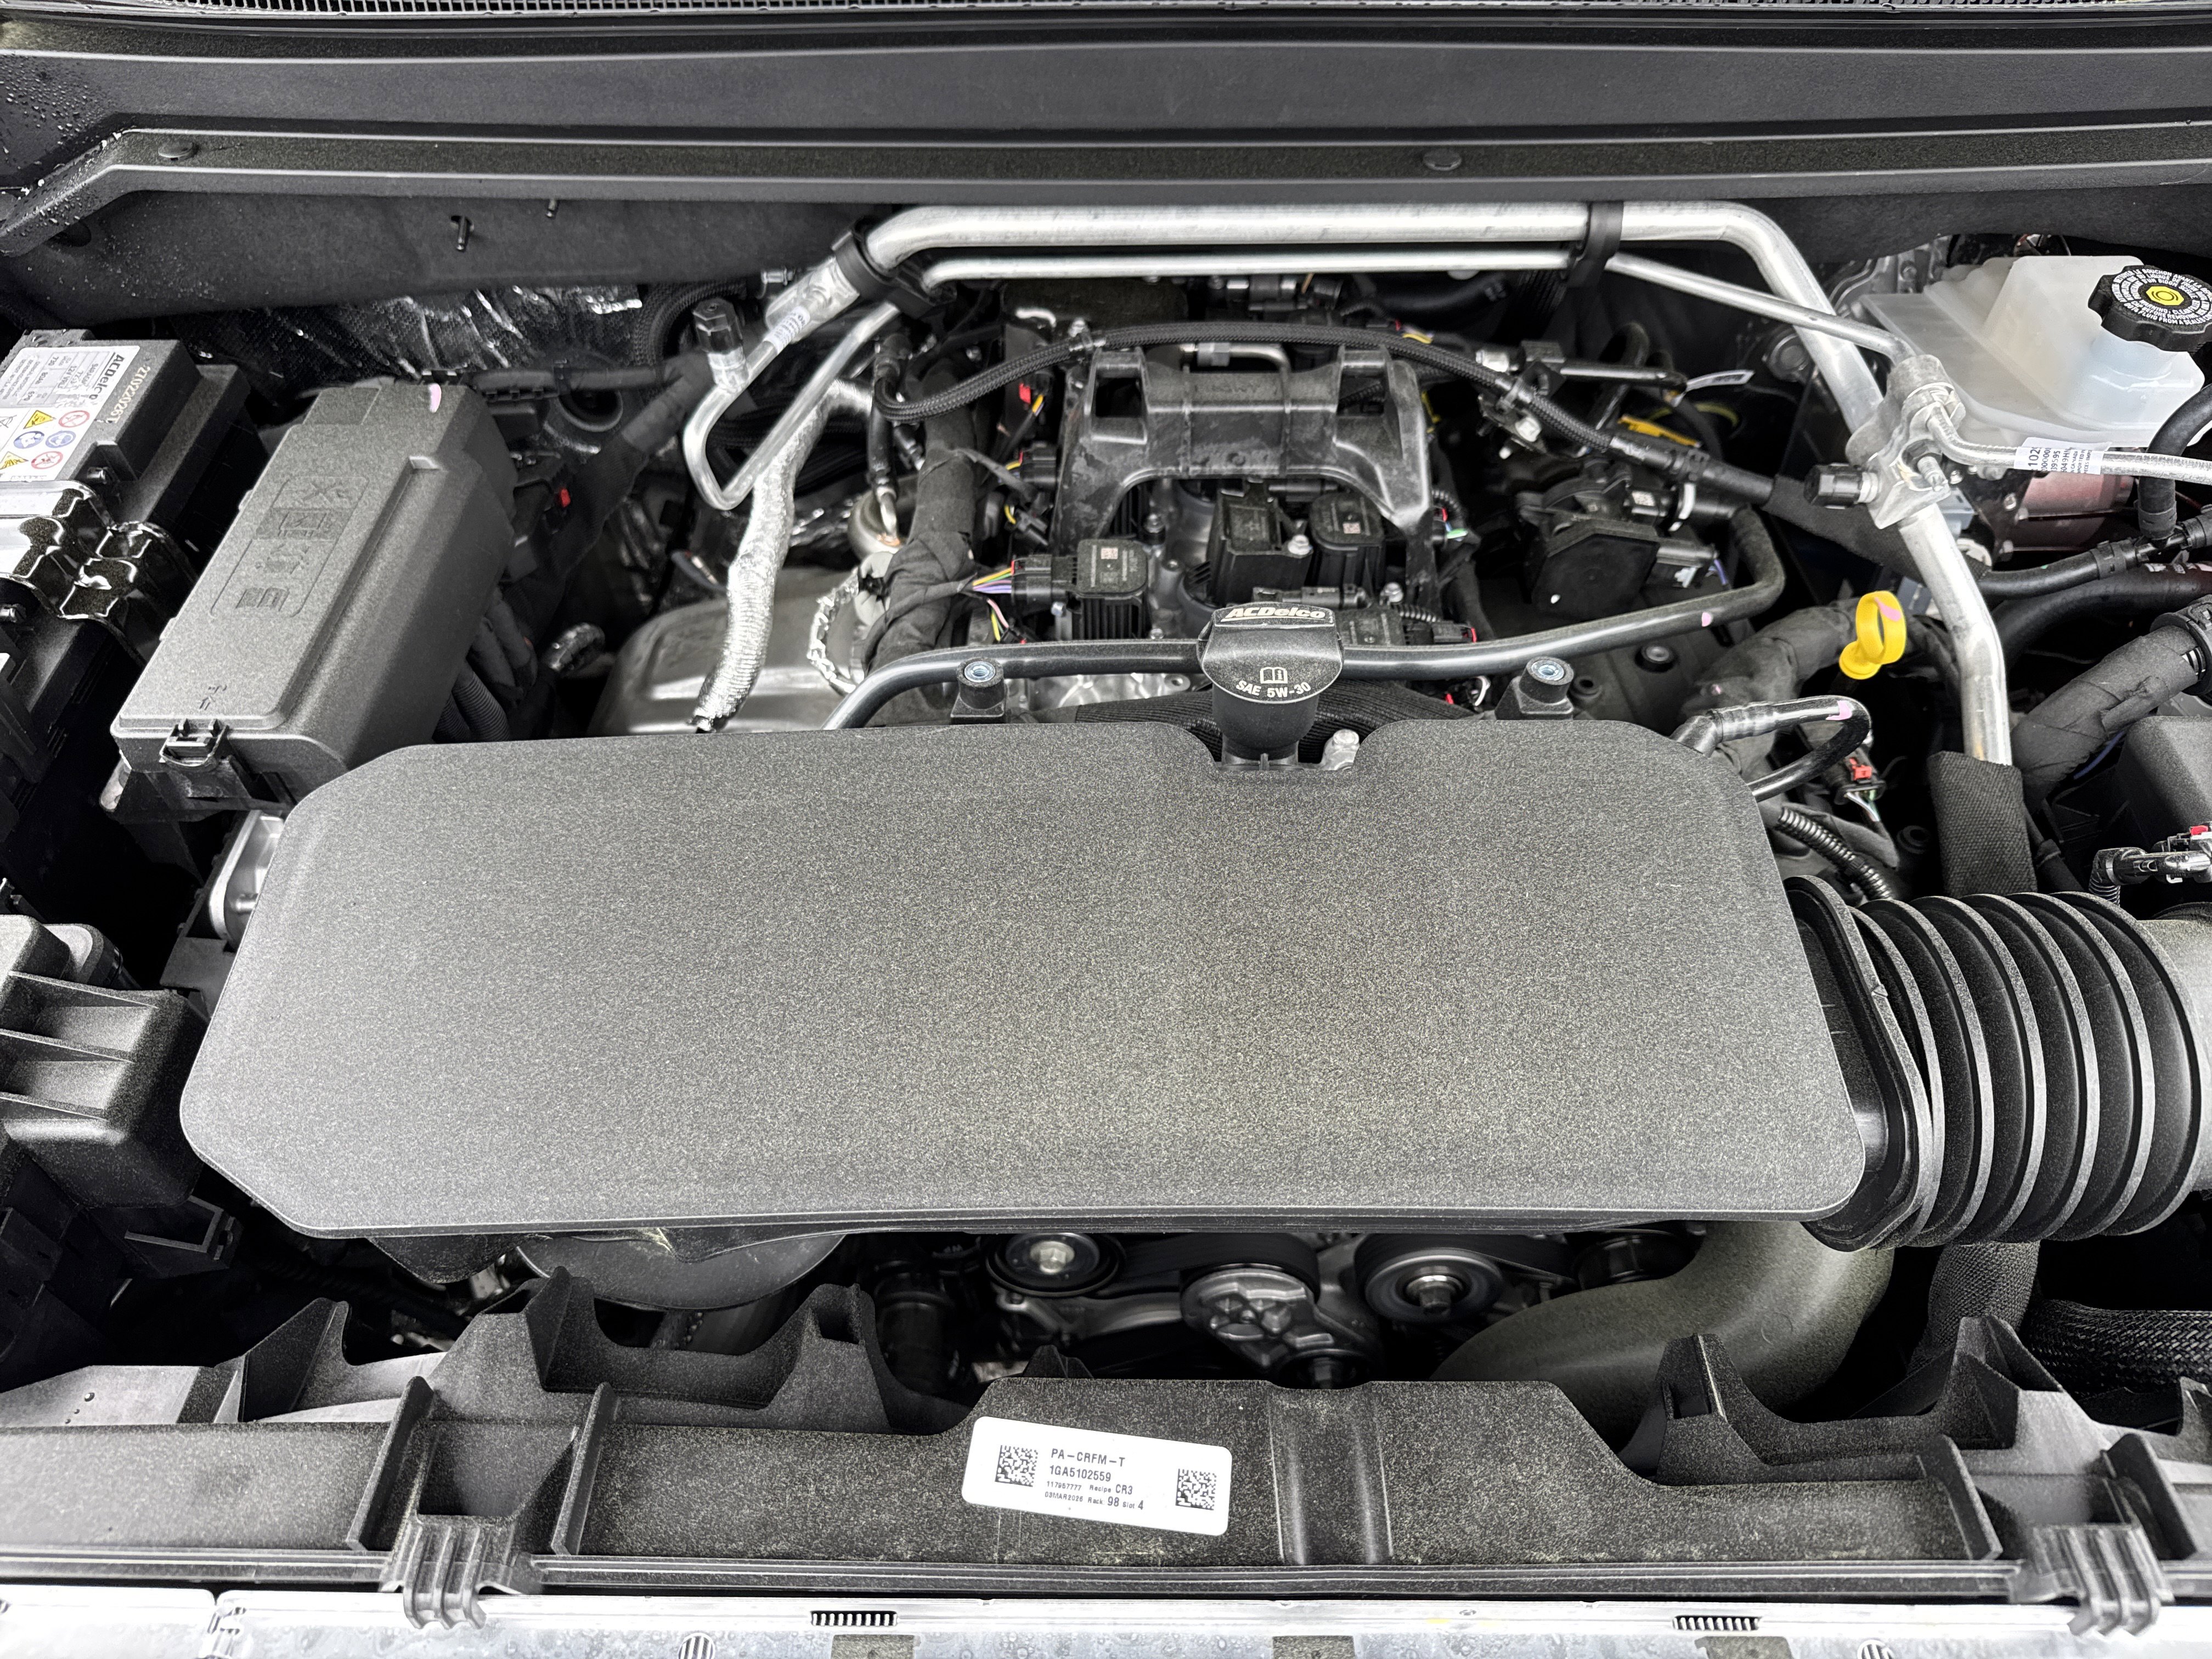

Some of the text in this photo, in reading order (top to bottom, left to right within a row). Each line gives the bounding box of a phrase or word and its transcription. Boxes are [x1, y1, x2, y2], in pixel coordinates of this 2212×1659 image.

[2158, 279, 2178, 287] BIDON
[2173, 274, 2194, 284] AVANT
[2138, 311, 2158, 320] FLUID
[2158, 315, 2178, 325] FROM
[2141, 307, 2166, 318] BEFORE
[88, 354, 125, 400] ACDelco
[1225, 607, 1325, 619] ACDelco
[1235, 680, 1311, 698] SAE 5W-30
[1049, 1465, 1112, 1482] 1GA5102559
[1090, 1485, 1111, 1493] Recipe
[1115, 1484, 1133, 1495] CR3
[1045, 1491, 1084, 1502] 03MAR2026
[1107, 1496, 1120, 1507] 98
[1137, 1500, 1144, 1510] 4
